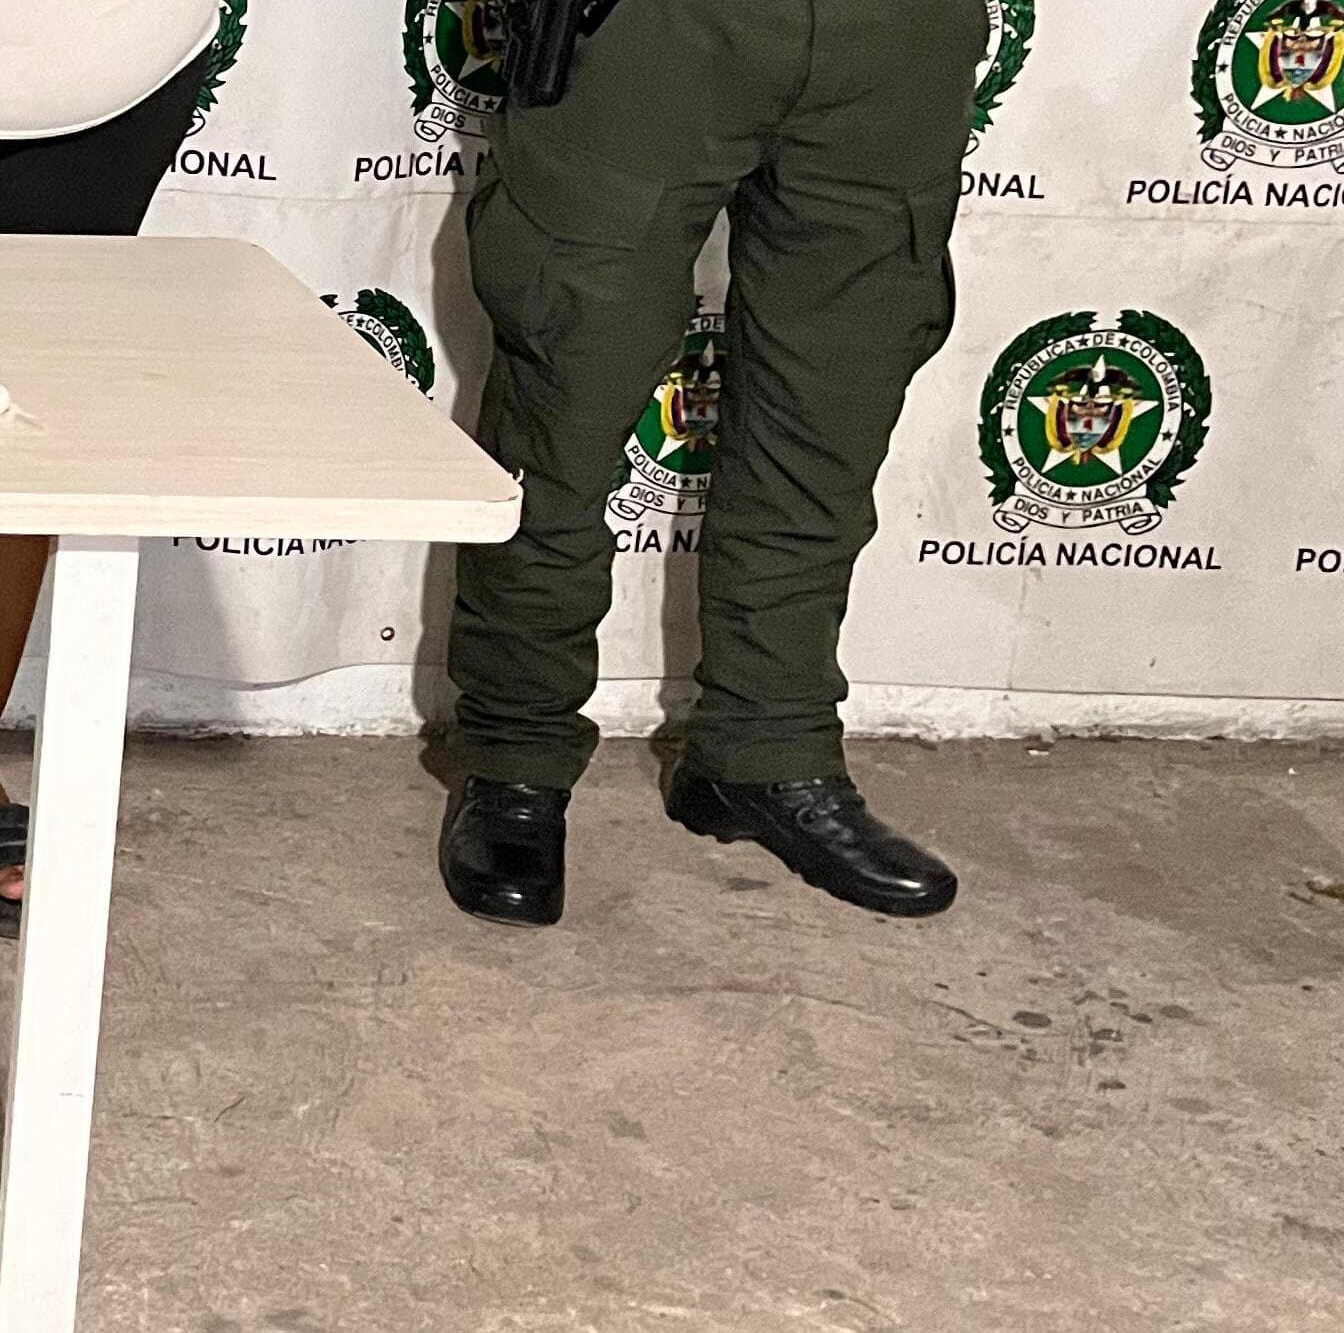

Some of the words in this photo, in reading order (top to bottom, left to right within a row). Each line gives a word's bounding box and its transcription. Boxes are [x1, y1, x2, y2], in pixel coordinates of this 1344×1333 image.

[355, 145, 463, 182] POLICÍA
[1127, 174, 1253, 205] POLICÍA
[919, 536, 1046, 566] POLICÍA
[1056, 543, 1221, 570] NACIONAL
